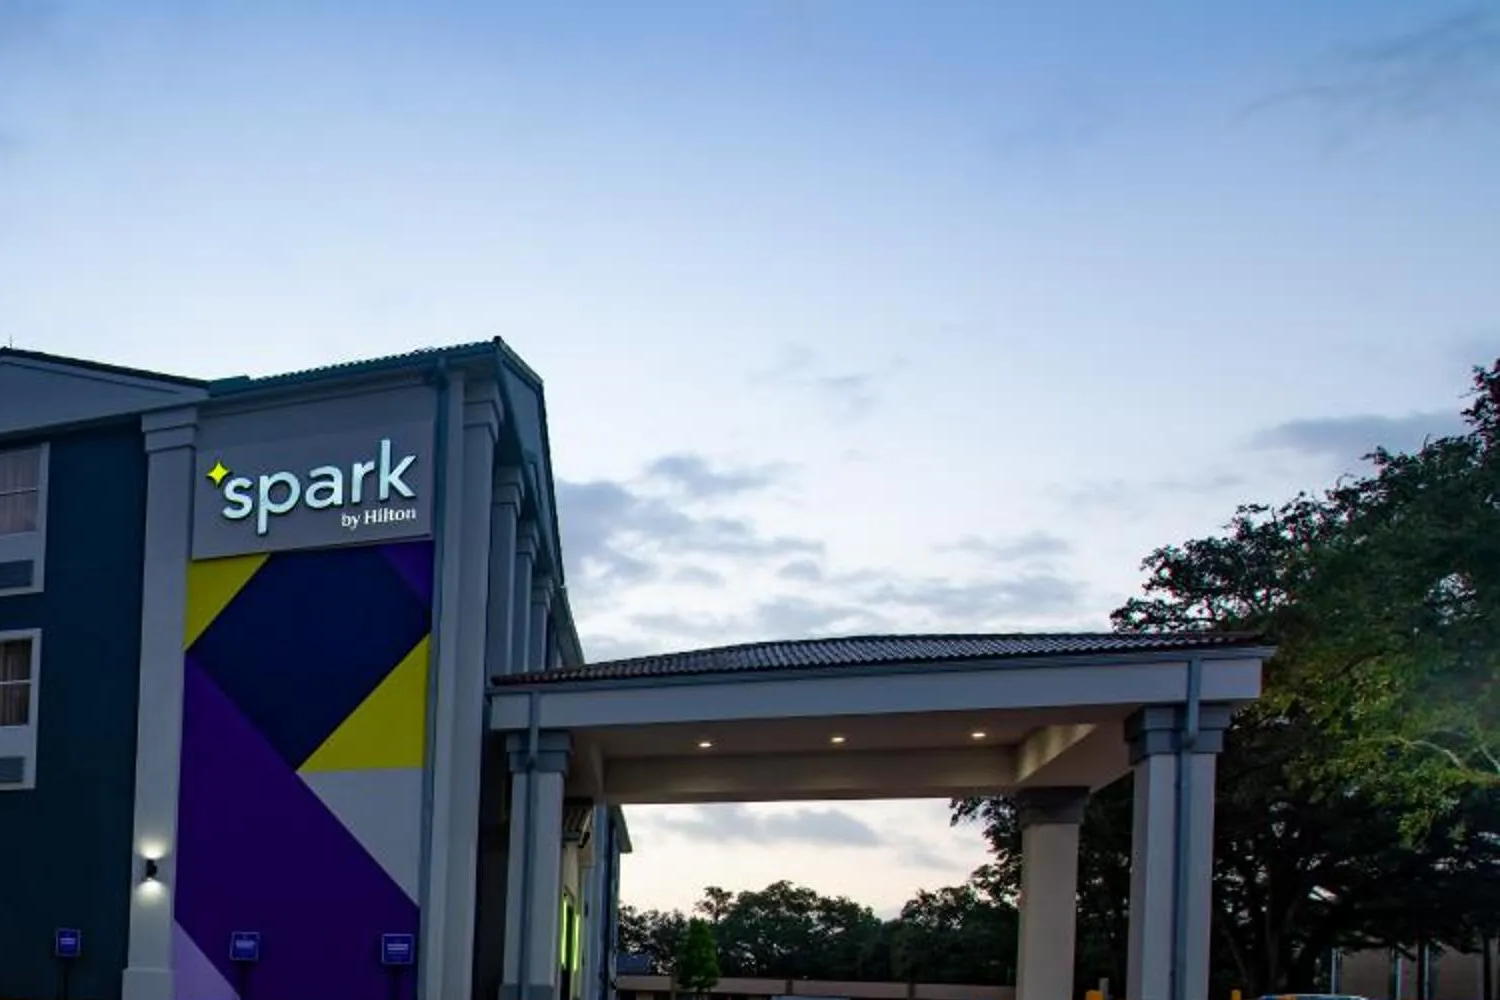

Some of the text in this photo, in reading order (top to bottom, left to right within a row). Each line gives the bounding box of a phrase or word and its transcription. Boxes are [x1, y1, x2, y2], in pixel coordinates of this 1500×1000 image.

[222, 439, 416, 533] spark
[341, 507, 416, 530] by Hilton
